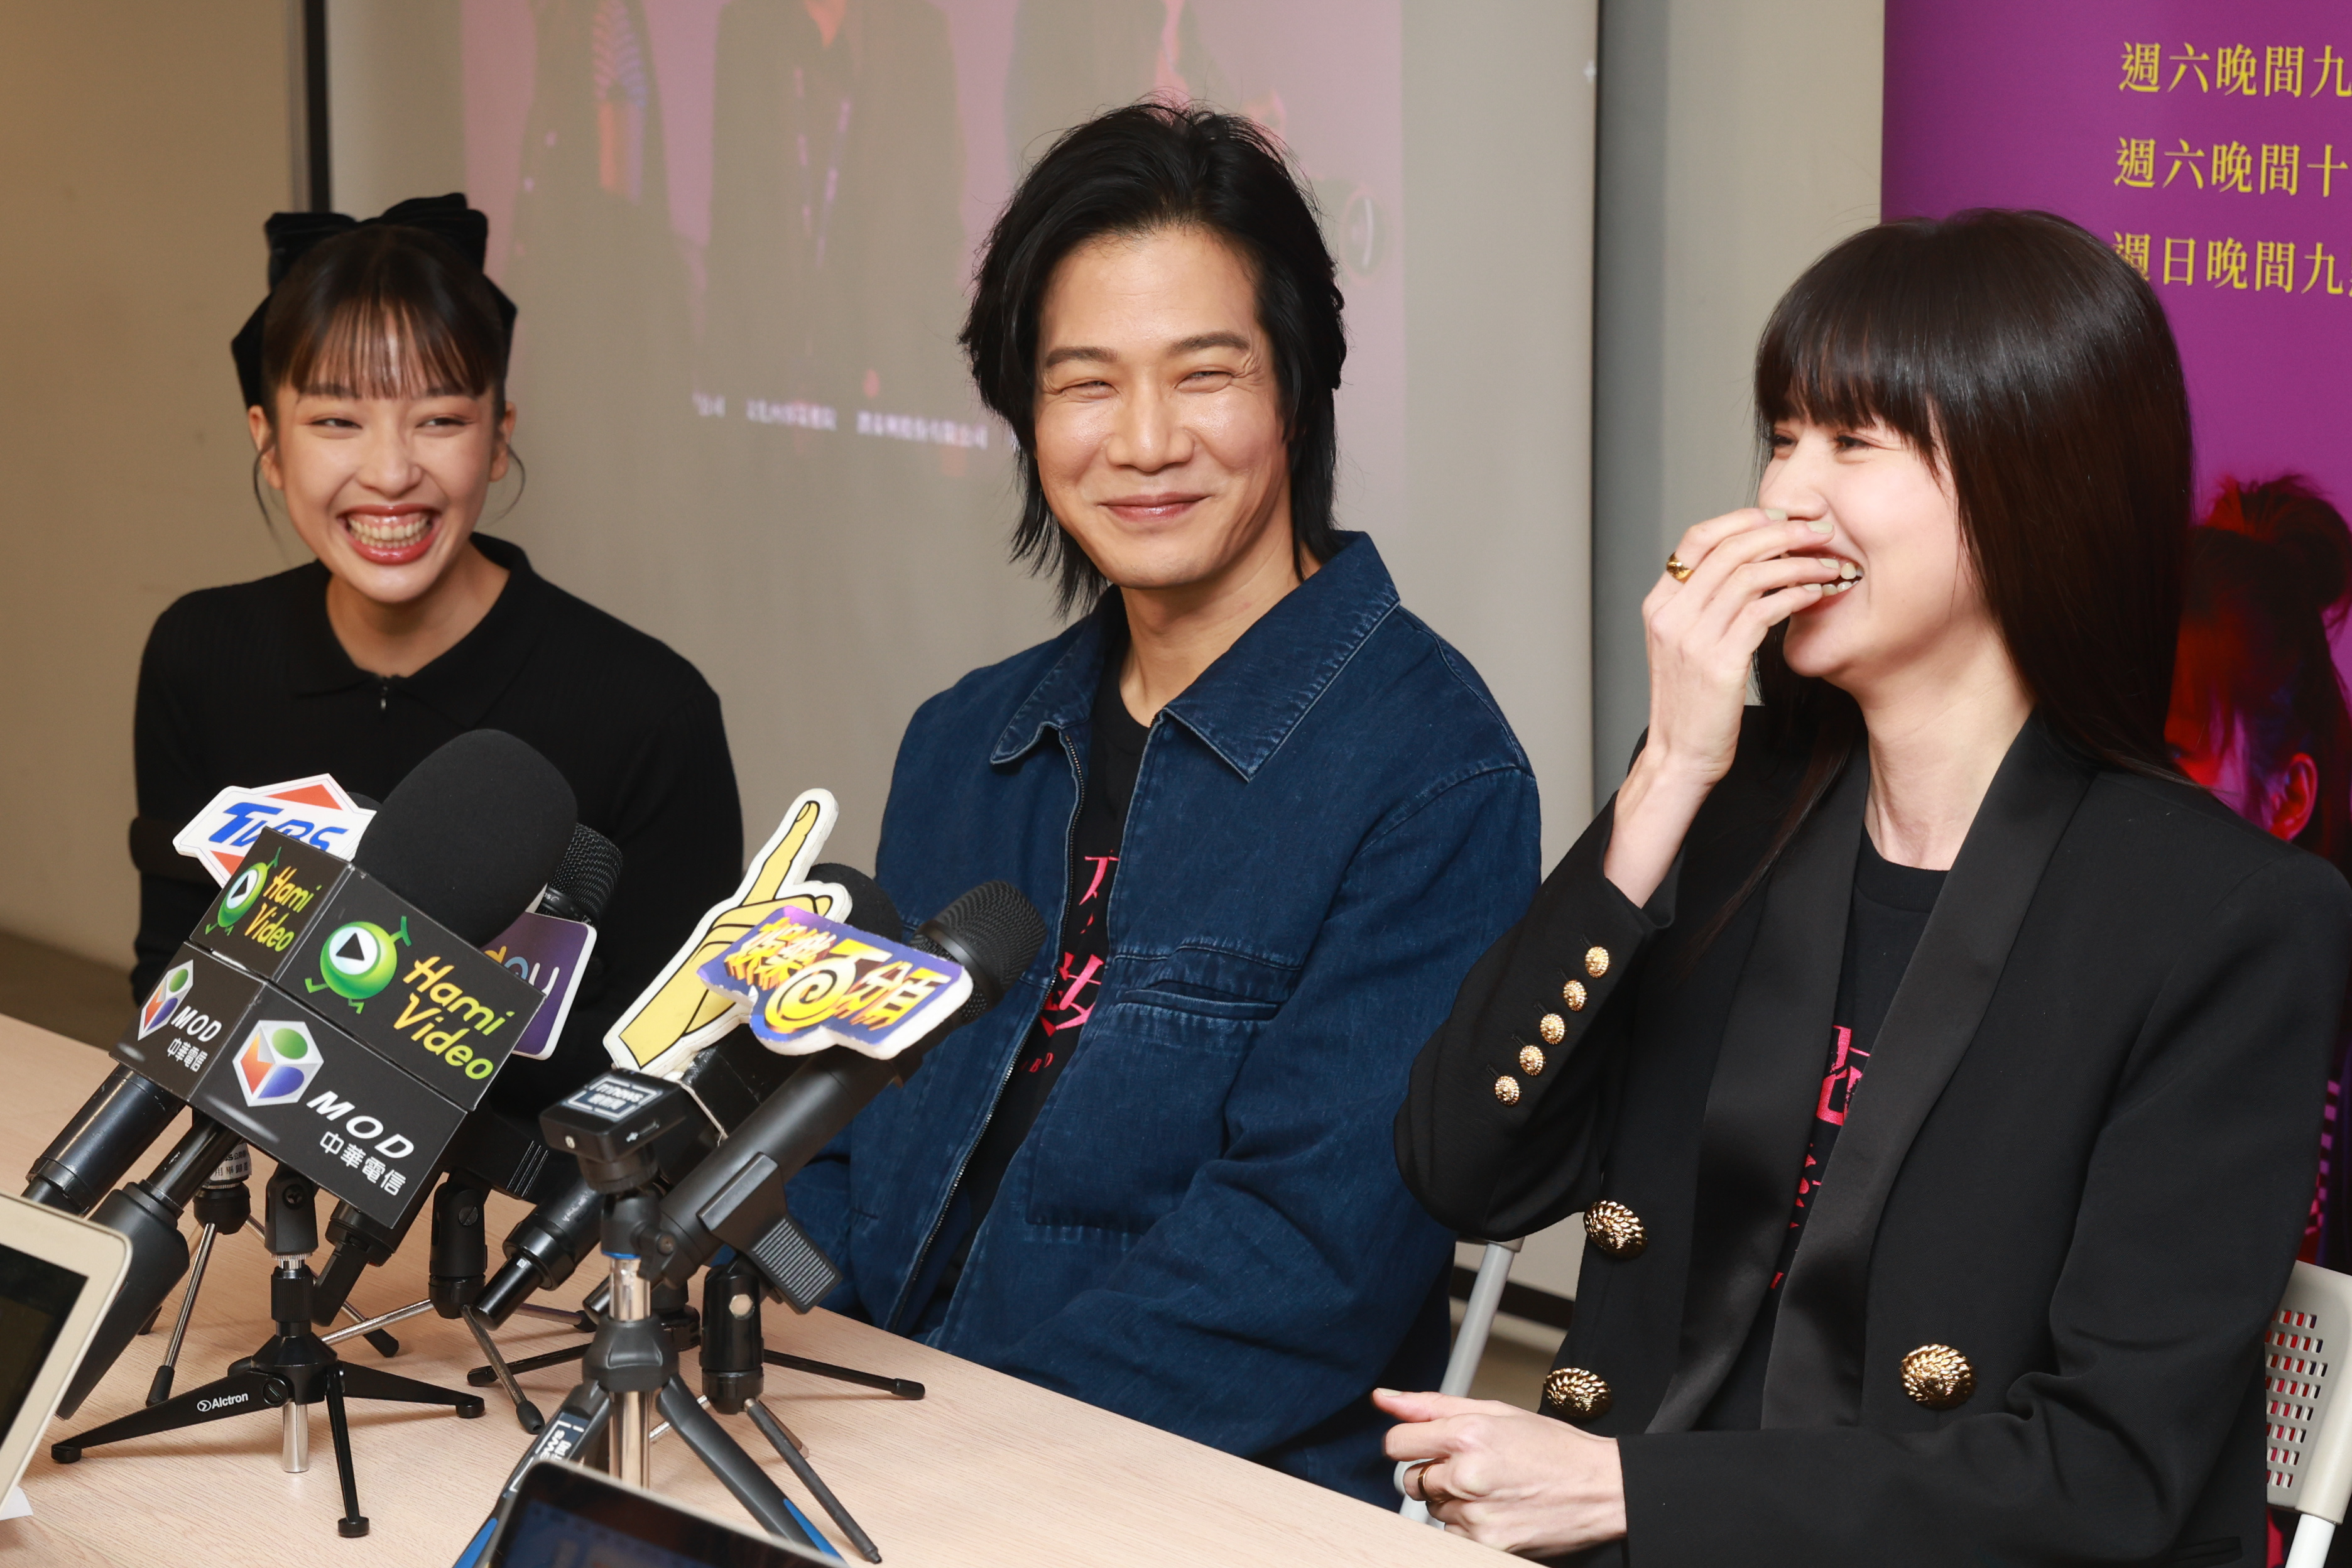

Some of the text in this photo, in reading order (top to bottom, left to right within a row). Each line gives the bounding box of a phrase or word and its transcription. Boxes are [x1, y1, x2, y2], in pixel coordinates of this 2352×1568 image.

[2119, 41, 2352, 98] 週六晚間九
[2114, 136, 2348, 197] 週六晚間十
[2113, 231, 2352, 297] 週日晚間九
[263, 866, 322, 912] Hami
[244, 903, 295, 952] Video
[170, 1006, 222, 1042] MOD
[403, 956, 515, 1035] Hami
[167, 1038, 208, 1072] 中華電信
[393, 993, 493, 1079] Video
[306, 1090, 415, 1158] MOD
[320, 1131, 406, 1195] 中華電信
[212, 1393, 249, 1409] Alctron
